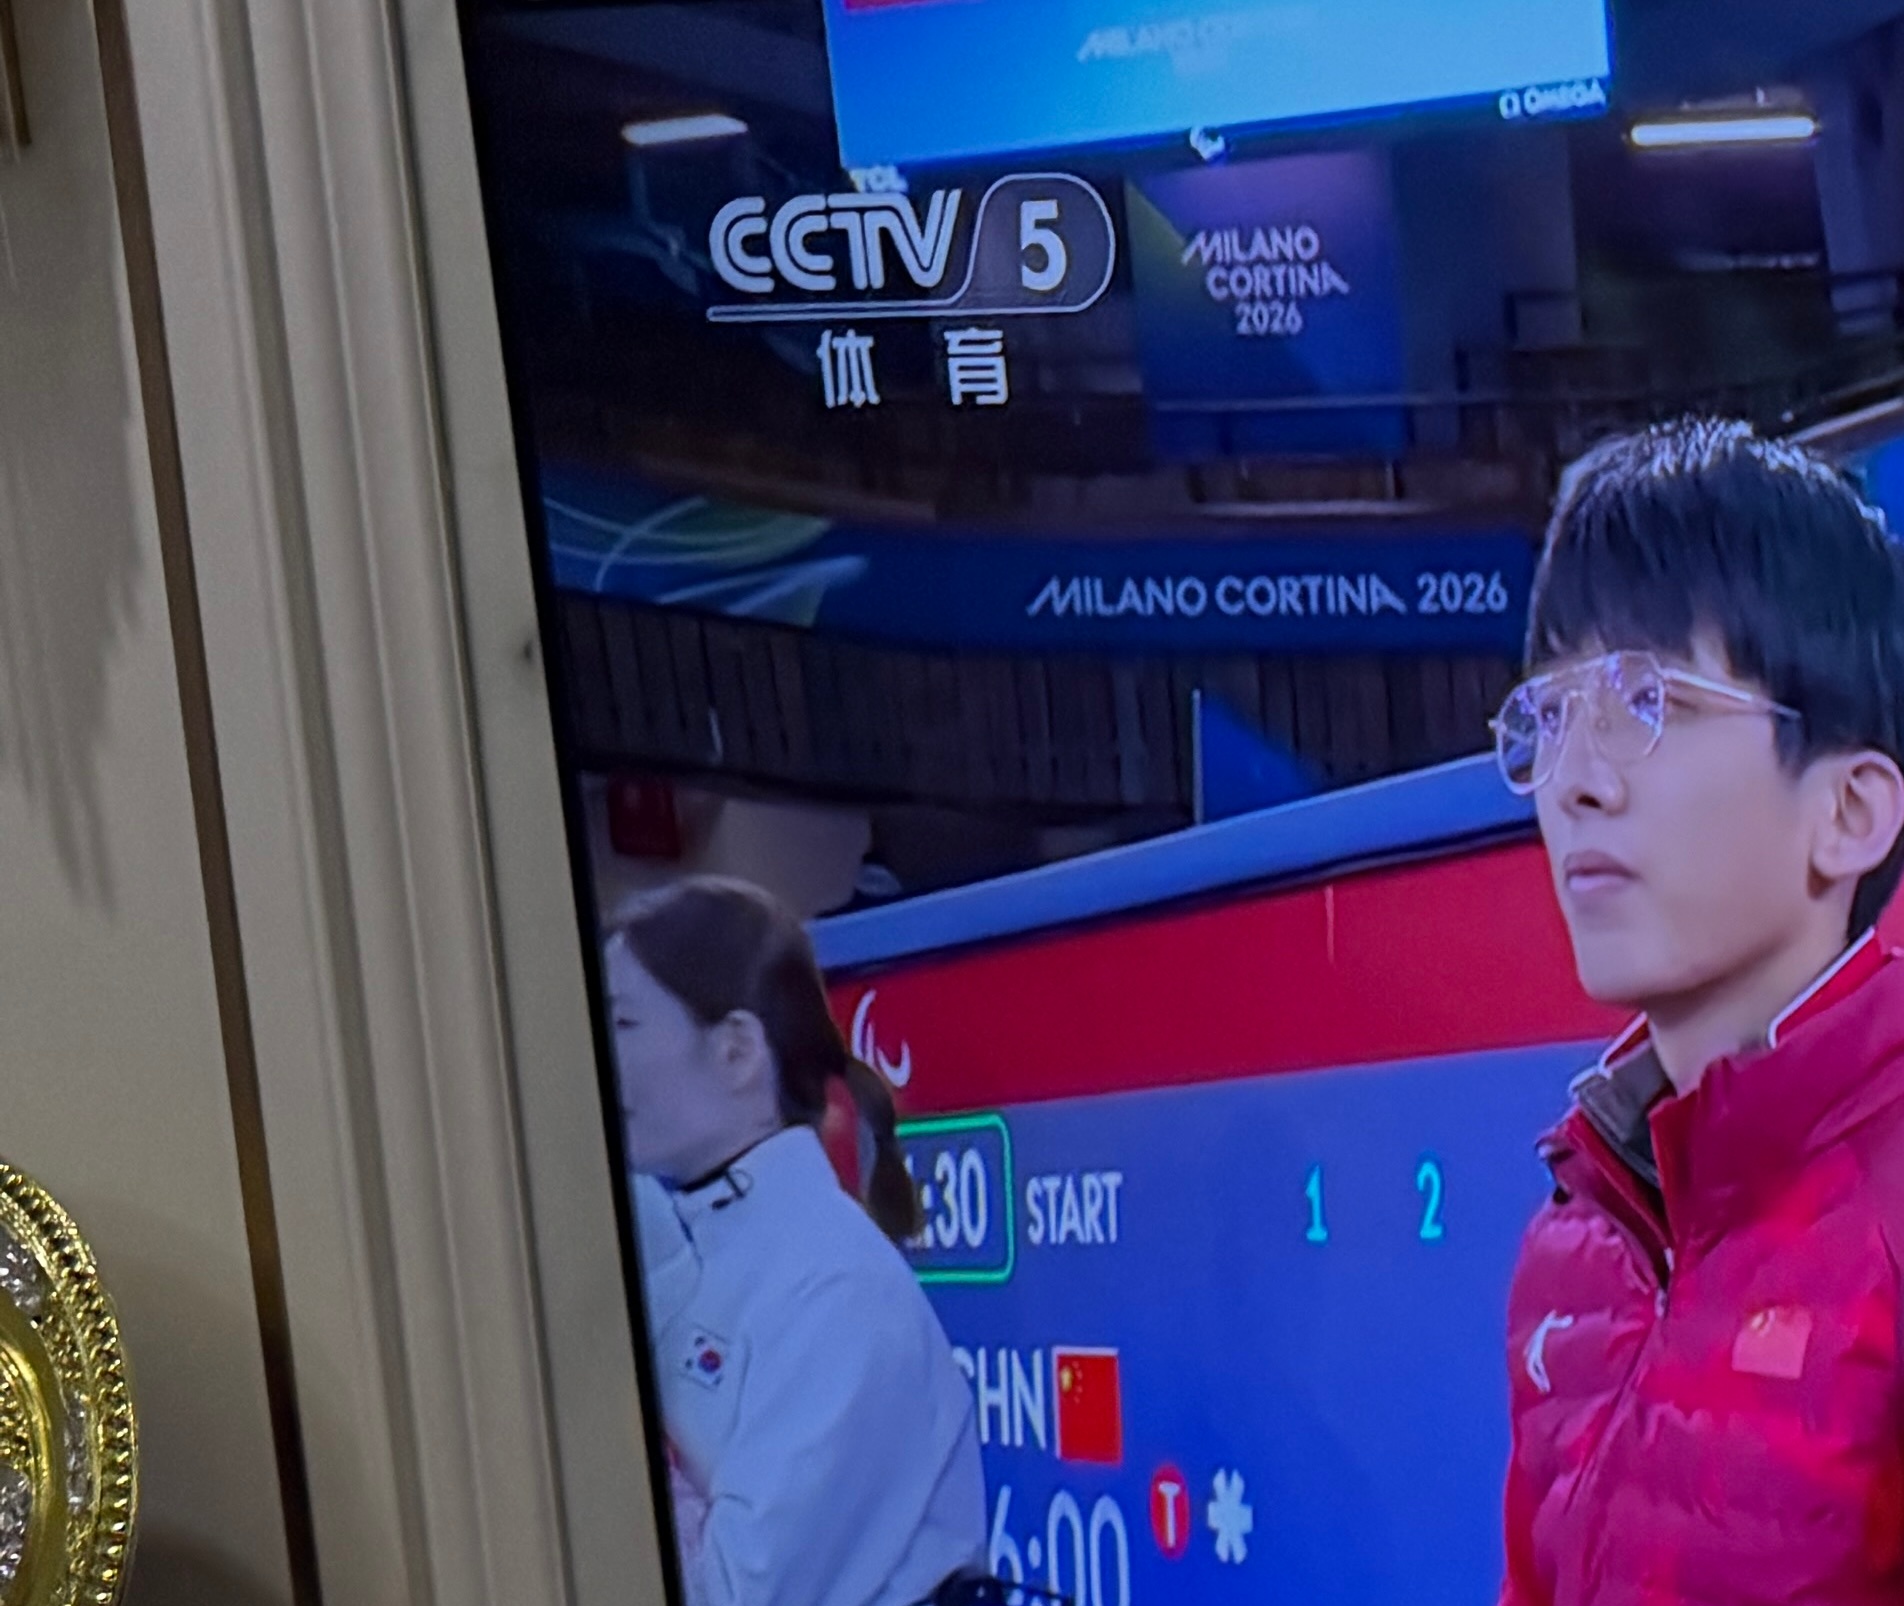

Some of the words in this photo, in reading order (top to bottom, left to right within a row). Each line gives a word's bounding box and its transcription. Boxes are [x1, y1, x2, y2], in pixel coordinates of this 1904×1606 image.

[708, 187, 962, 294] CCTV
[1020, 199, 1068, 292] 5
[1181, 225, 1320, 267] MILANO
[1206, 261, 1350, 301] CORTINA
[1235, 300, 1304, 335] 2026
[816, 328, 1010, 409] 体育
[1025, 574, 1208, 617] MILANO
[1214, 573, 1408, 617] CORTINA
[1416, 570, 1508, 614] 2026
[1024, 1171, 1123, 1245] START
[1304, 1163, 1328, 1243] 1
[1416, 1159, 1444, 1240] 2
